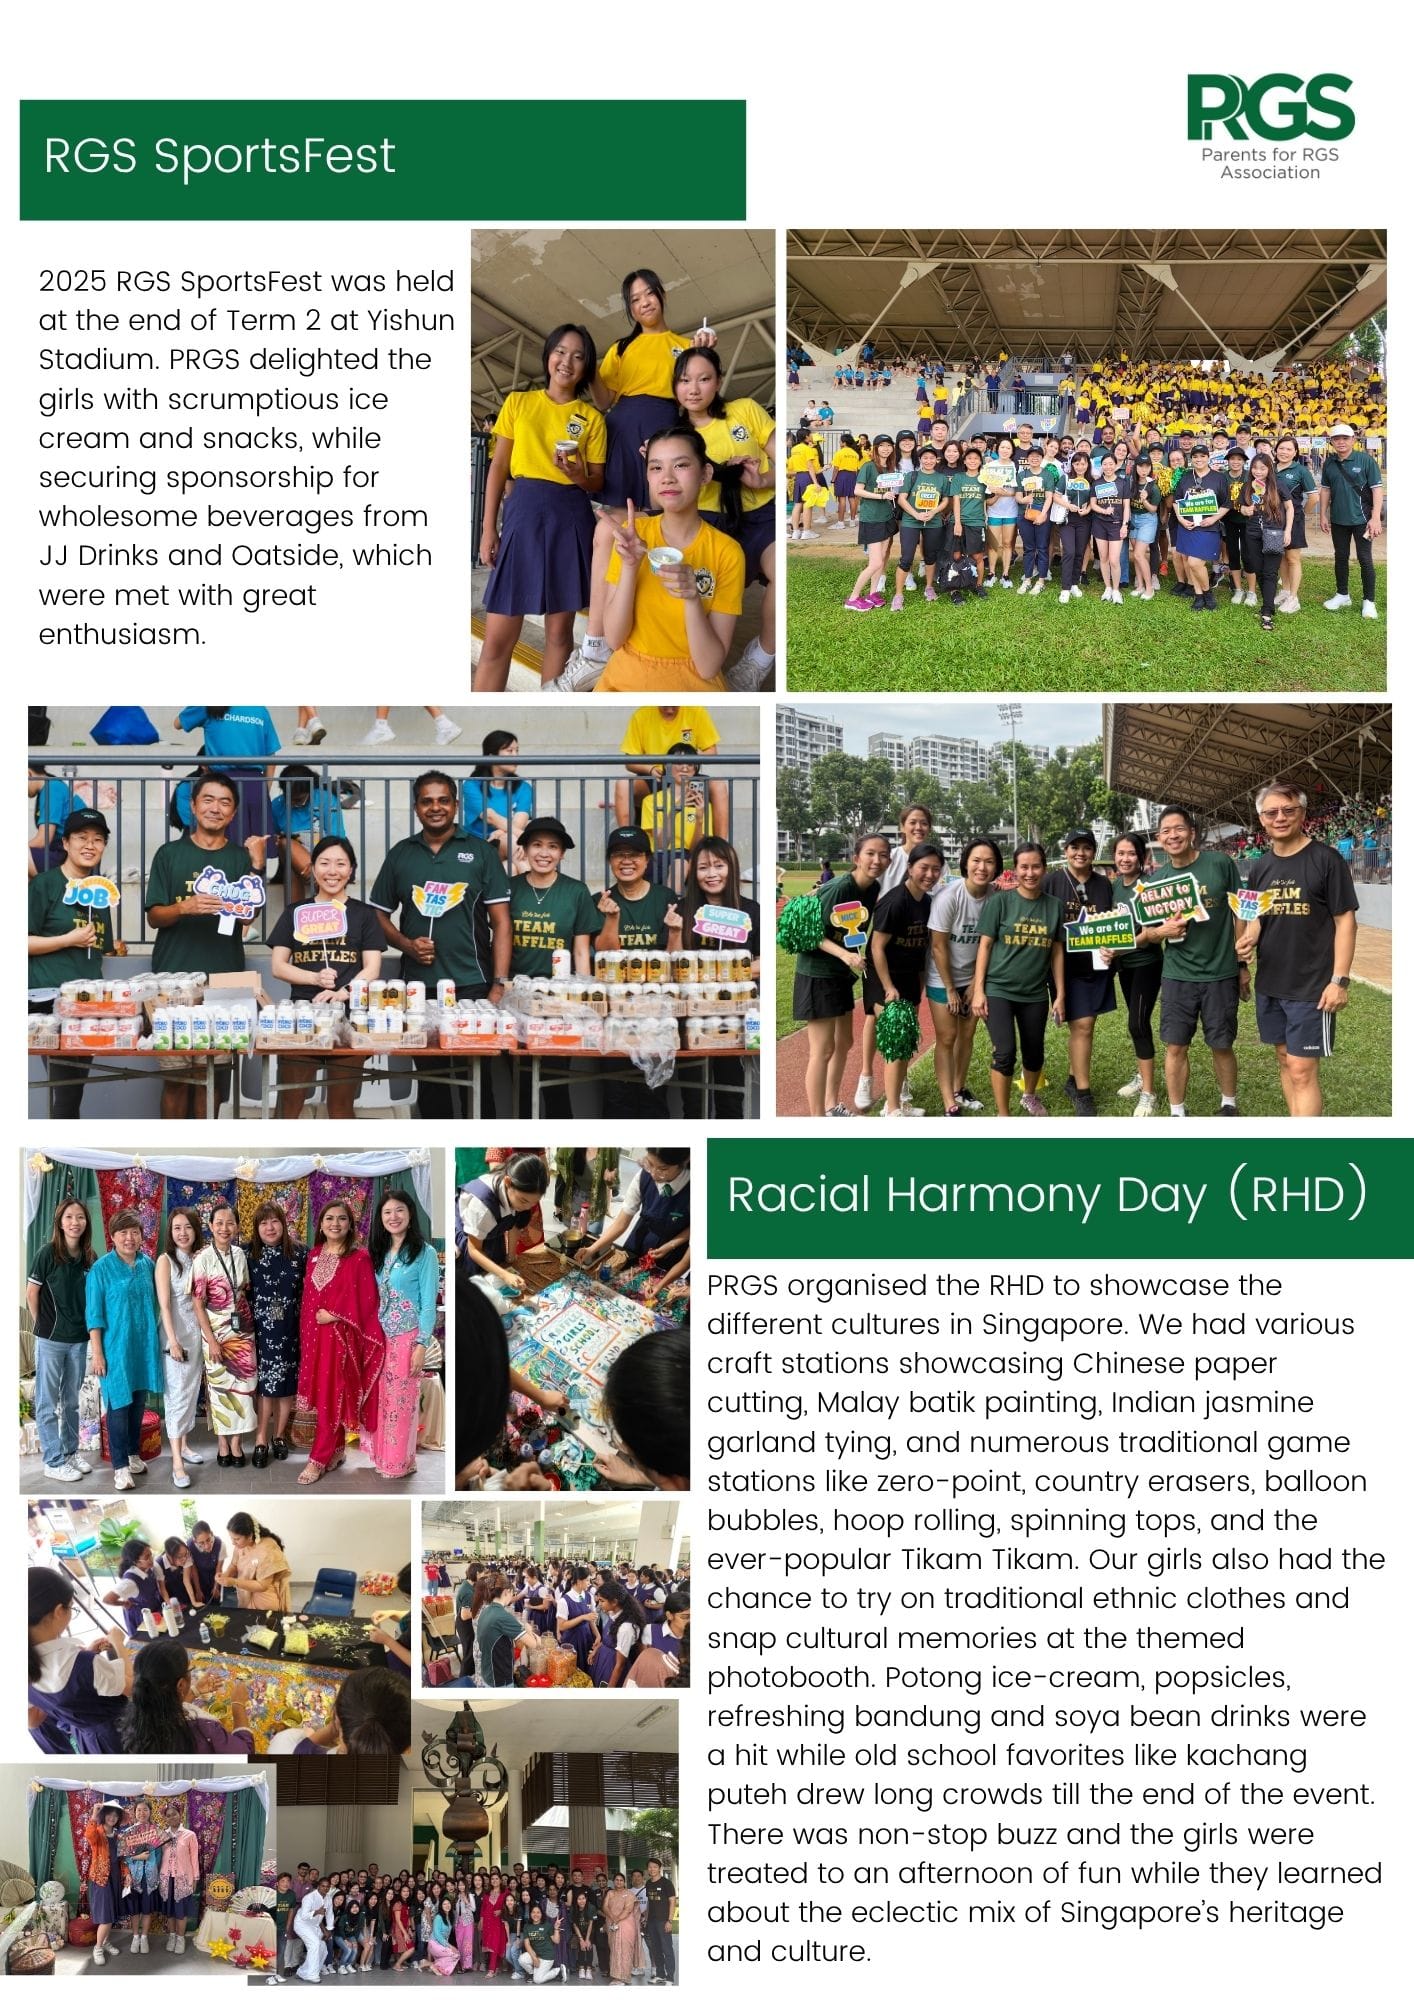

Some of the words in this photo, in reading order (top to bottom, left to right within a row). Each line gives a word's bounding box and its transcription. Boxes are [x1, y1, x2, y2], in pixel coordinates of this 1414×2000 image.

[46, 137, 137, 173] RGS
[155, 137, 396, 186] SportsFest
[1202, 147, 1267, 162] Parents
[1272, 147, 1297, 162] for
[1302, 147, 1340, 162] RGS
[1220, 164, 1320, 180] Association
[39, 269, 107, 292] 2025
[117, 270, 171, 292] RGS
[181, 270, 323, 299] SportsFest
[330, 274, 386, 292] was
[396, 269, 454, 292] held
[39, 309, 68, 331] at
[75, 308, 120, 331] the
[128, 308, 181, 331] end
[190, 307, 217, 331] of
[226, 309, 296, 331] Term
[306, 308, 321, 331] 2
[330, 309, 359, 331] at
[367, 308, 455, 331] Yishun
[39, 347, 160, 370] Stadium.
[170, 348, 240, 370] PRGS
[249, 347, 378, 378] delighted
[387, 347, 432, 370] the
[39, 387, 94, 418] girls
[103, 387, 158, 410] with
[168, 387, 339, 417] scrumptious
[349, 387, 389, 410] ice
[39, 431, 129, 449] cream
[139, 426, 193, 449] and
[203, 426, 303, 453] snacks,
[311, 426, 382, 449] while
[39, 465, 156, 496] securing
[166, 465, 334, 496] sponsorship
[342, 464, 380, 488] for
[1067, 482, 1085, 490] JOB
[38, 504, 198, 527] wholesome
[207, 504, 354, 535] beverages
[363, 503, 428, 527] from
[39, 544, 67, 566] JJ
[79, 543, 159, 566] Drinks
[168, 543, 222, 566] and
[231, 543, 344, 570] Oatside,
[352, 543, 432, 566] which
[38, 588, 105, 606] were
[115, 584, 170, 606] met
[178, 583, 233, 606] with
[242, 584, 317, 614] great
[39, 622, 206, 645] enthusiasm.
[216, 713, 265, 727] CHARDSON
[64, 886, 109, 907] JOB
[424, 882, 447, 895] FAN
[1140, 884, 1174, 903] RELAY
[1175, 883, 1191, 895] to
[1237, 890, 1258, 901] FAN
[425, 894, 447, 905] TAS
[1143, 897, 1194, 917] VICTORY
[1239, 899, 1259, 911] TAS
[300, 909, 339, 924] SUPER
[423, 905, 443, 916] TIC
[708, 909, 741, 922] SUPER
[1240, 908, 1257, 920] TIC
[1261, 902, 1311, 916] FFLES
[301, 921, 341, 935] GREAT
[513, 919, 556, 934] TEAM
[702, 922, 742, 938] GREAT
[1013, 922, 1048, 935] TEAM
[1079, 925, 1094, 936] We
[1096, 924, 1112, 932] are
[1113, 921, 1129, 932] for
[511, 935, 565, 949] AFFLES
[619, 933, 658, 946] TEAM
[950, 933, 981, 944] RAFF
[1004, 934, 1053, 948] RAFFLES
[1069, 935, 1094, 947] TEAM
[1095, 933, 1134, 945] RAFFLES
[293, 950, 358, 964] RAFFLES
[729, 1174, 869, 1213] Racial
[888, 1176, 1102, 1224] Harmony
[1119, 1176, 1208, 1224] Day
[1230, 1162, 1366, 1221] (RHD)
[708, 1274, 778, 1296] PRGS
[787, 1273, 927, 1304] organised
[935, 1273, 980, 1296] the
[990, 1274, 1044, 1296] RHD
[1052, 1274, 1081, 1296] to
[1090, 1273, 1230, 1296] showcase
[1238, 1273, 1283, 1296] the
[707, 1311, 823, 1335] different
[831, 1312, 940, 1335] cultures
[950, 1312, 972, 1335] in
[982, 1312, 1129, 1343] Singapore.
[1138, 1313, 1183, 1335] We
[1192, 1312, 1245, 1335] had
[1255, 1311, 1355, 1335] various
[707, 1390, 808, 1421] cutting,
[818, 1390, 900, 1420] Malay
[909, 1390, 976, 1413] batik
[985, 1390, 1103, 1421] painting,
[1112, 1390, 1195, 1413] Indian
[1202, 1390, 1314, 1420] jasmine
[708, 1468, 816, 1492] stations
[826, 1469, 868, 1492] like
[877, 1469, 1026, 1500] zero-point,
[1035, 1470, 1140, 1499] country
[1148, 1474, 1256, 1496] erasers,
[1265, 1469, 1367, 1492] balloon
[707, 1748, 725, 1766] a
[735, 1743, 769, 1766] hit
[776, 1743, 846, 1766] while
[855, 1743, 897, 1766] old
[907, 1743, 996, 1766] school
[1005, 1742, 1125, 1766] favorites
[1135, 1742, 1177, 1766] like
[1187, 1743, 1307, 1774] kachang
[707, 1900, 790, 1923] about
[798, 1900, 843, 1923] the
[851, 1899, 959, 1923] eclectic
[969, 1900, 1016, 1923] mix
[1024, 1899, 1052, 1923] of
[1061, 1899, 1219, 1931] Singapore’s
[1229, 1900, 1344, 1931] heritage
